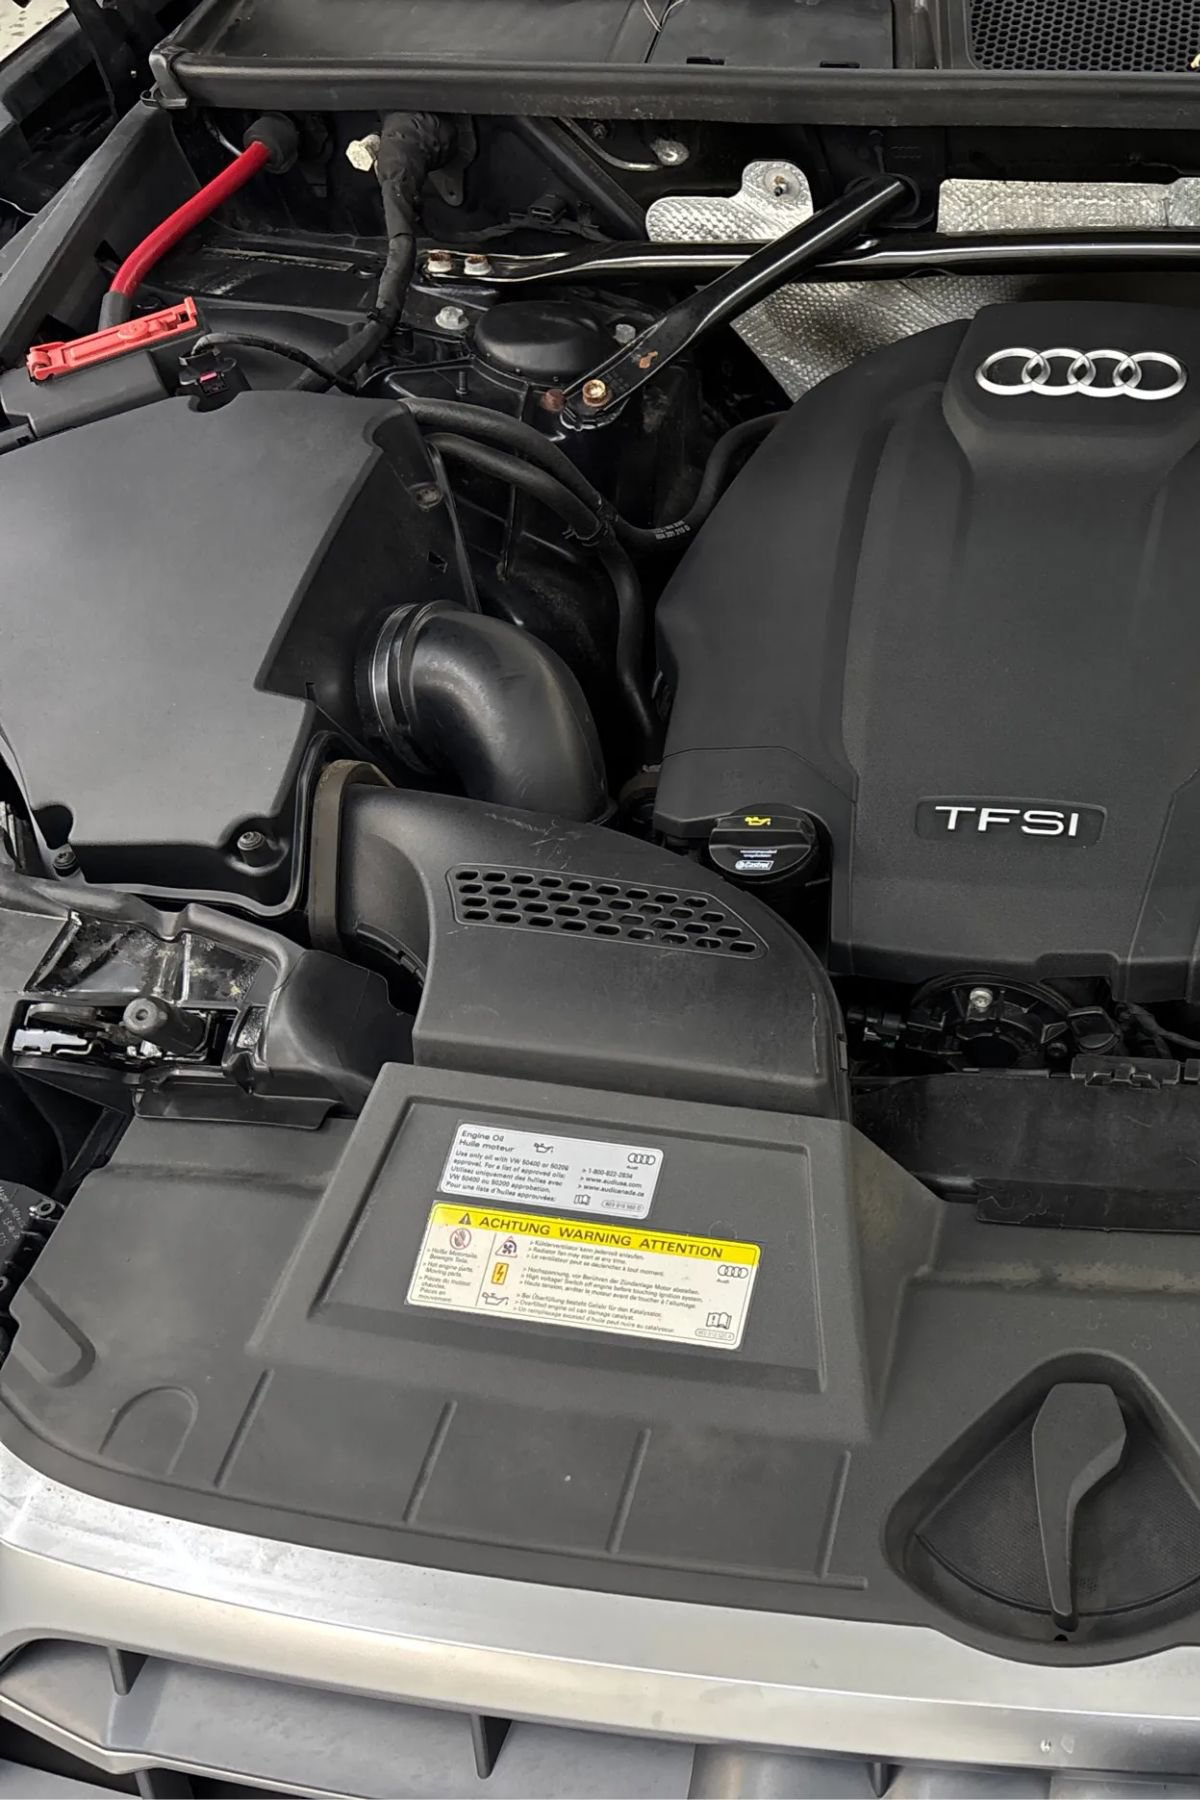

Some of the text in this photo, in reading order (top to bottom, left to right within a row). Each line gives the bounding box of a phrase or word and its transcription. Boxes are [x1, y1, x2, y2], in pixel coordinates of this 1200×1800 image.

[935, 806, 1079, 836] TFSI
[460, 1130, 504, 1142] Engine Oil
[458, 1139, 514, 1152] Huile moteur
[468, 1152, 482, 1160] only
[474, 1168, 513, 1179] uniquement
[521, 1167, 551, 1176] approved
[445, 1181, 461, 1189] Pour
[478, 1216, 723, 1258] ACHTUNG WARNING ATTENTION
